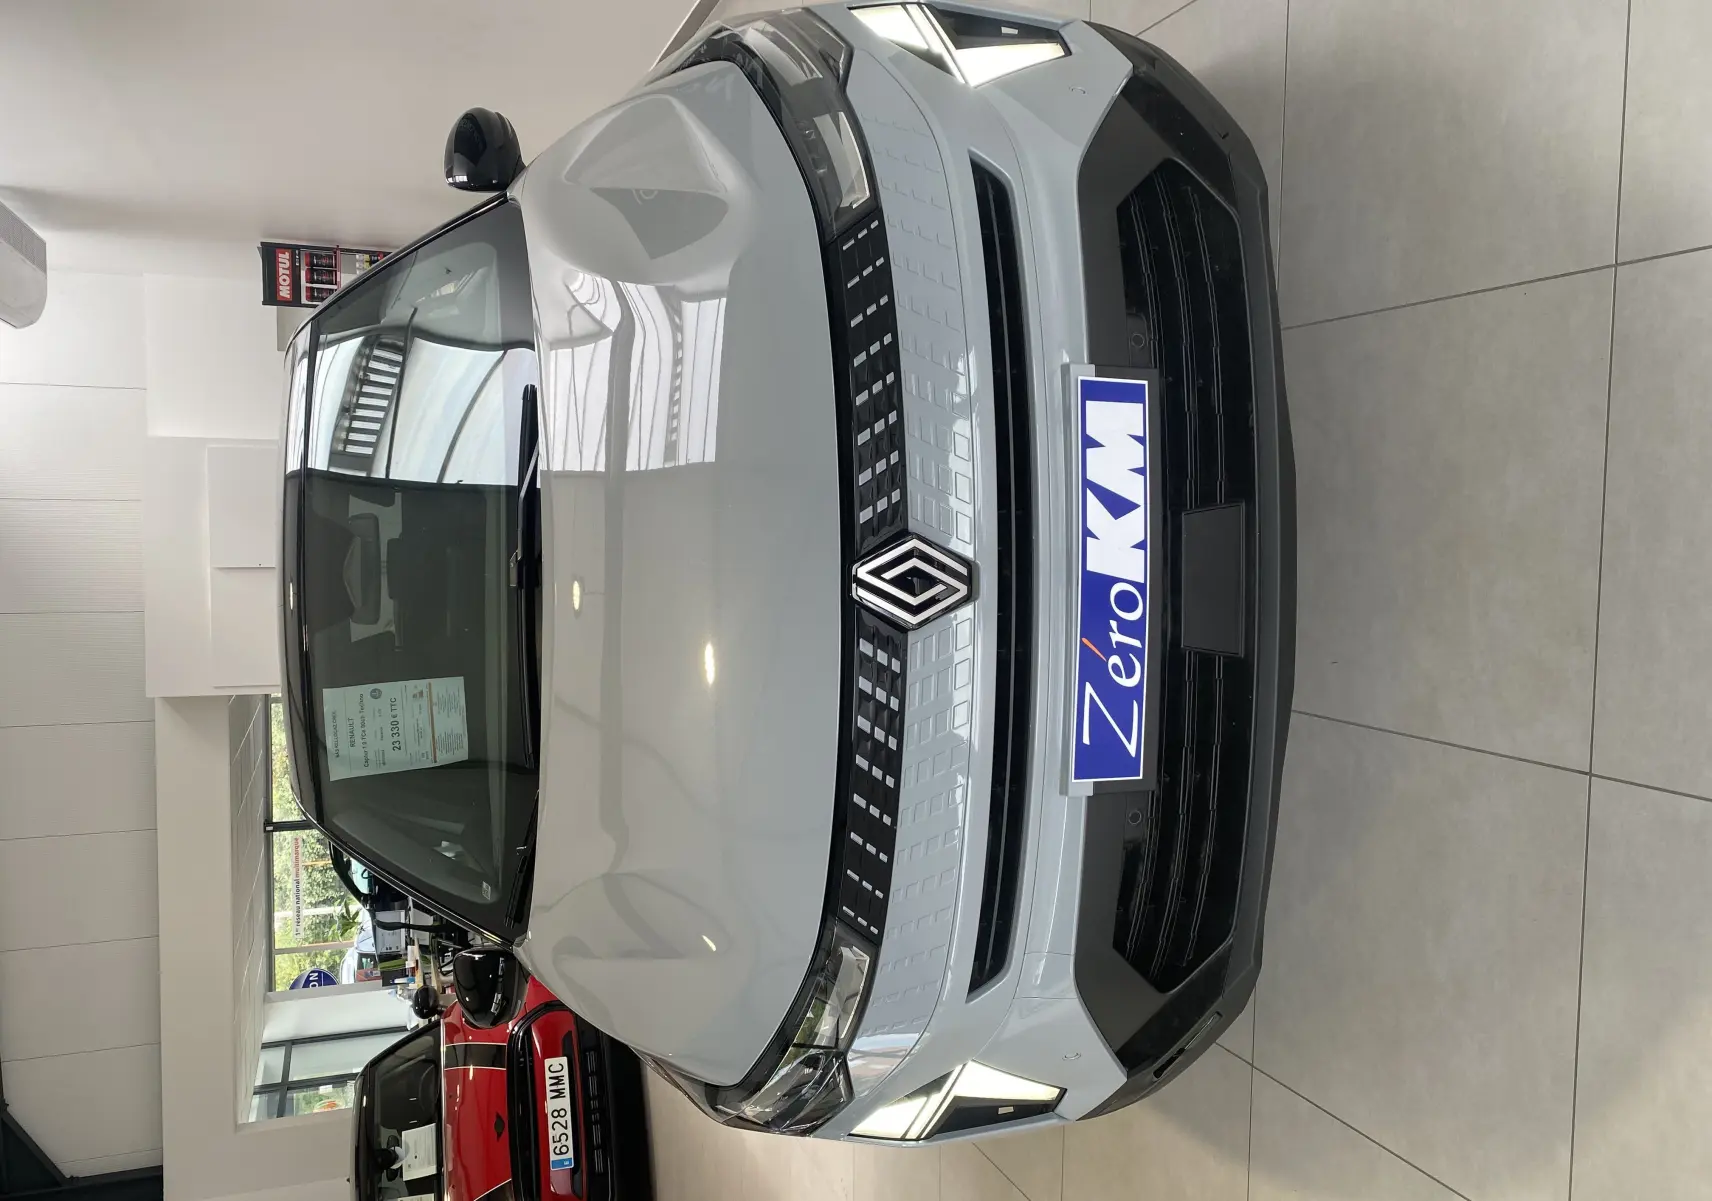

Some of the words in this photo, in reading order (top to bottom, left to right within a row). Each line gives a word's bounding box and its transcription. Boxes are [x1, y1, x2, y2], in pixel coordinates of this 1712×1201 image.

[279, 252, 290, 298] MOTUL
[390, 697, 398, 712] TTC
[348, 718, 356, 748] RENAULT
[390, 720, 400, 738] 330
[392, 740, 402, 752] 23
[362, 750, 370, 768] Captur
[548, 1063, 566, 1099] MMC
[551, 1108, 568, 1155] 6528
